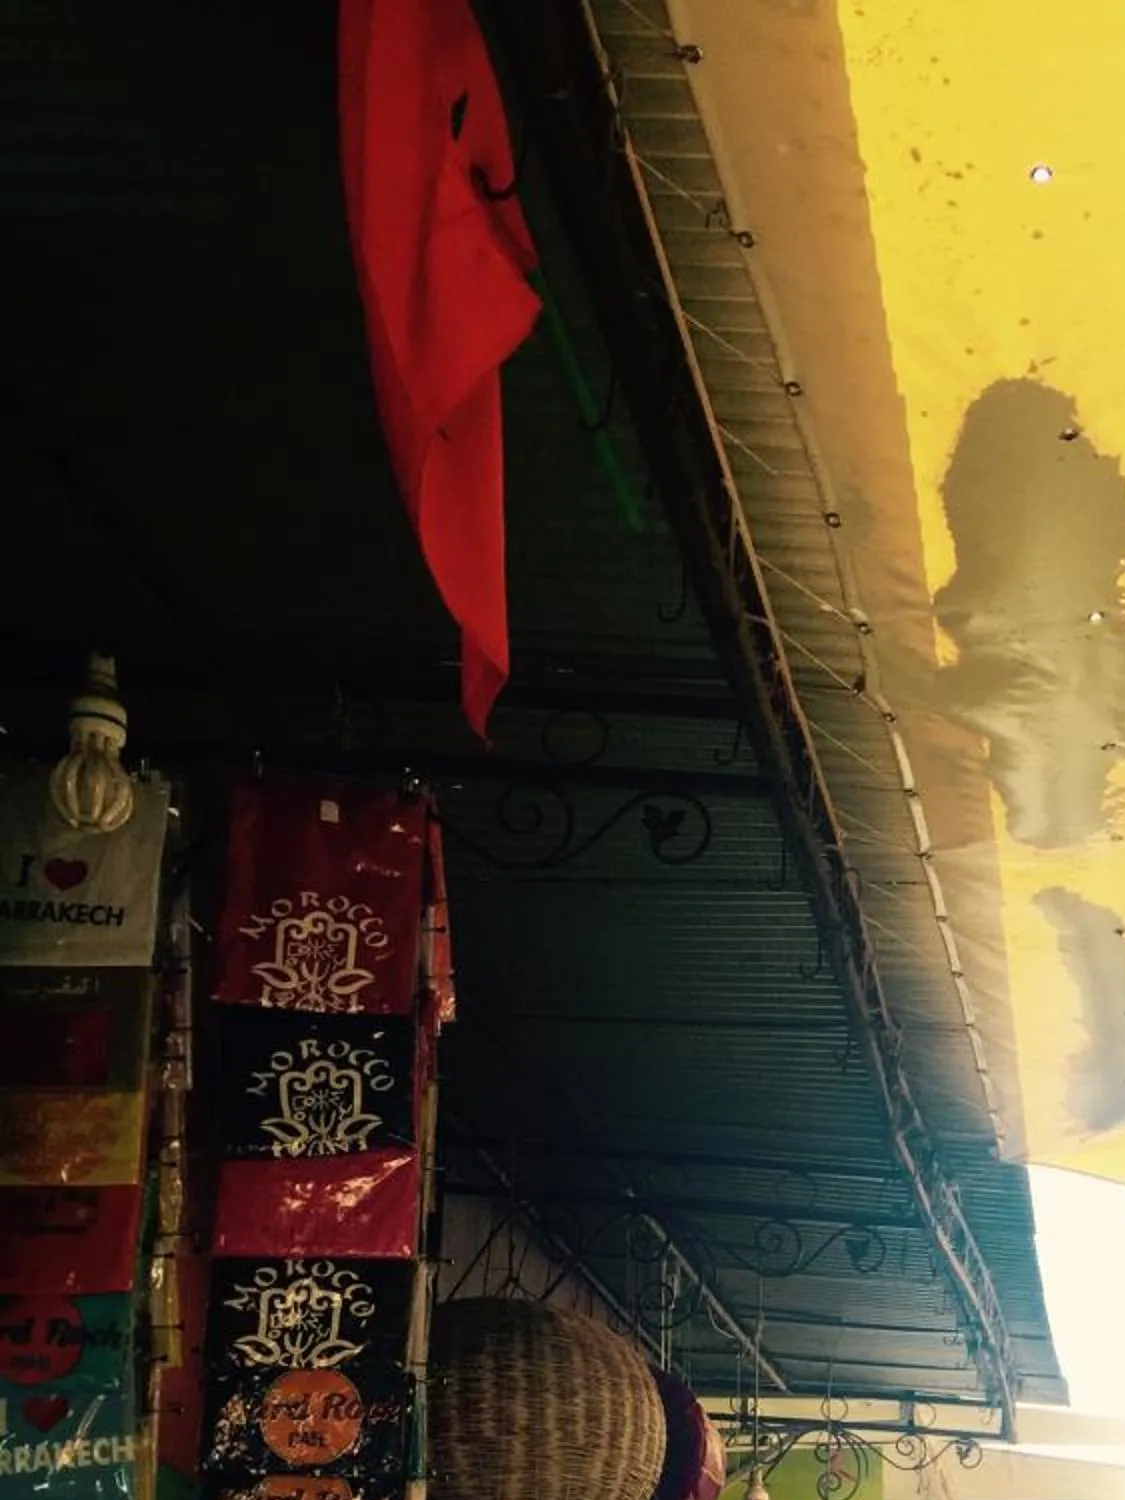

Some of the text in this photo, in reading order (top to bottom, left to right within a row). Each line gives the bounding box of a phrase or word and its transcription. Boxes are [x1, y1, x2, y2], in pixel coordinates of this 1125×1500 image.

[17, 854, 34, 887] I
[238, 891, 389, 947] MOROCCO
[246, 1039, 395, 1096] MOROCCO
[224, 1259, 375, 1313] MOROCCO
